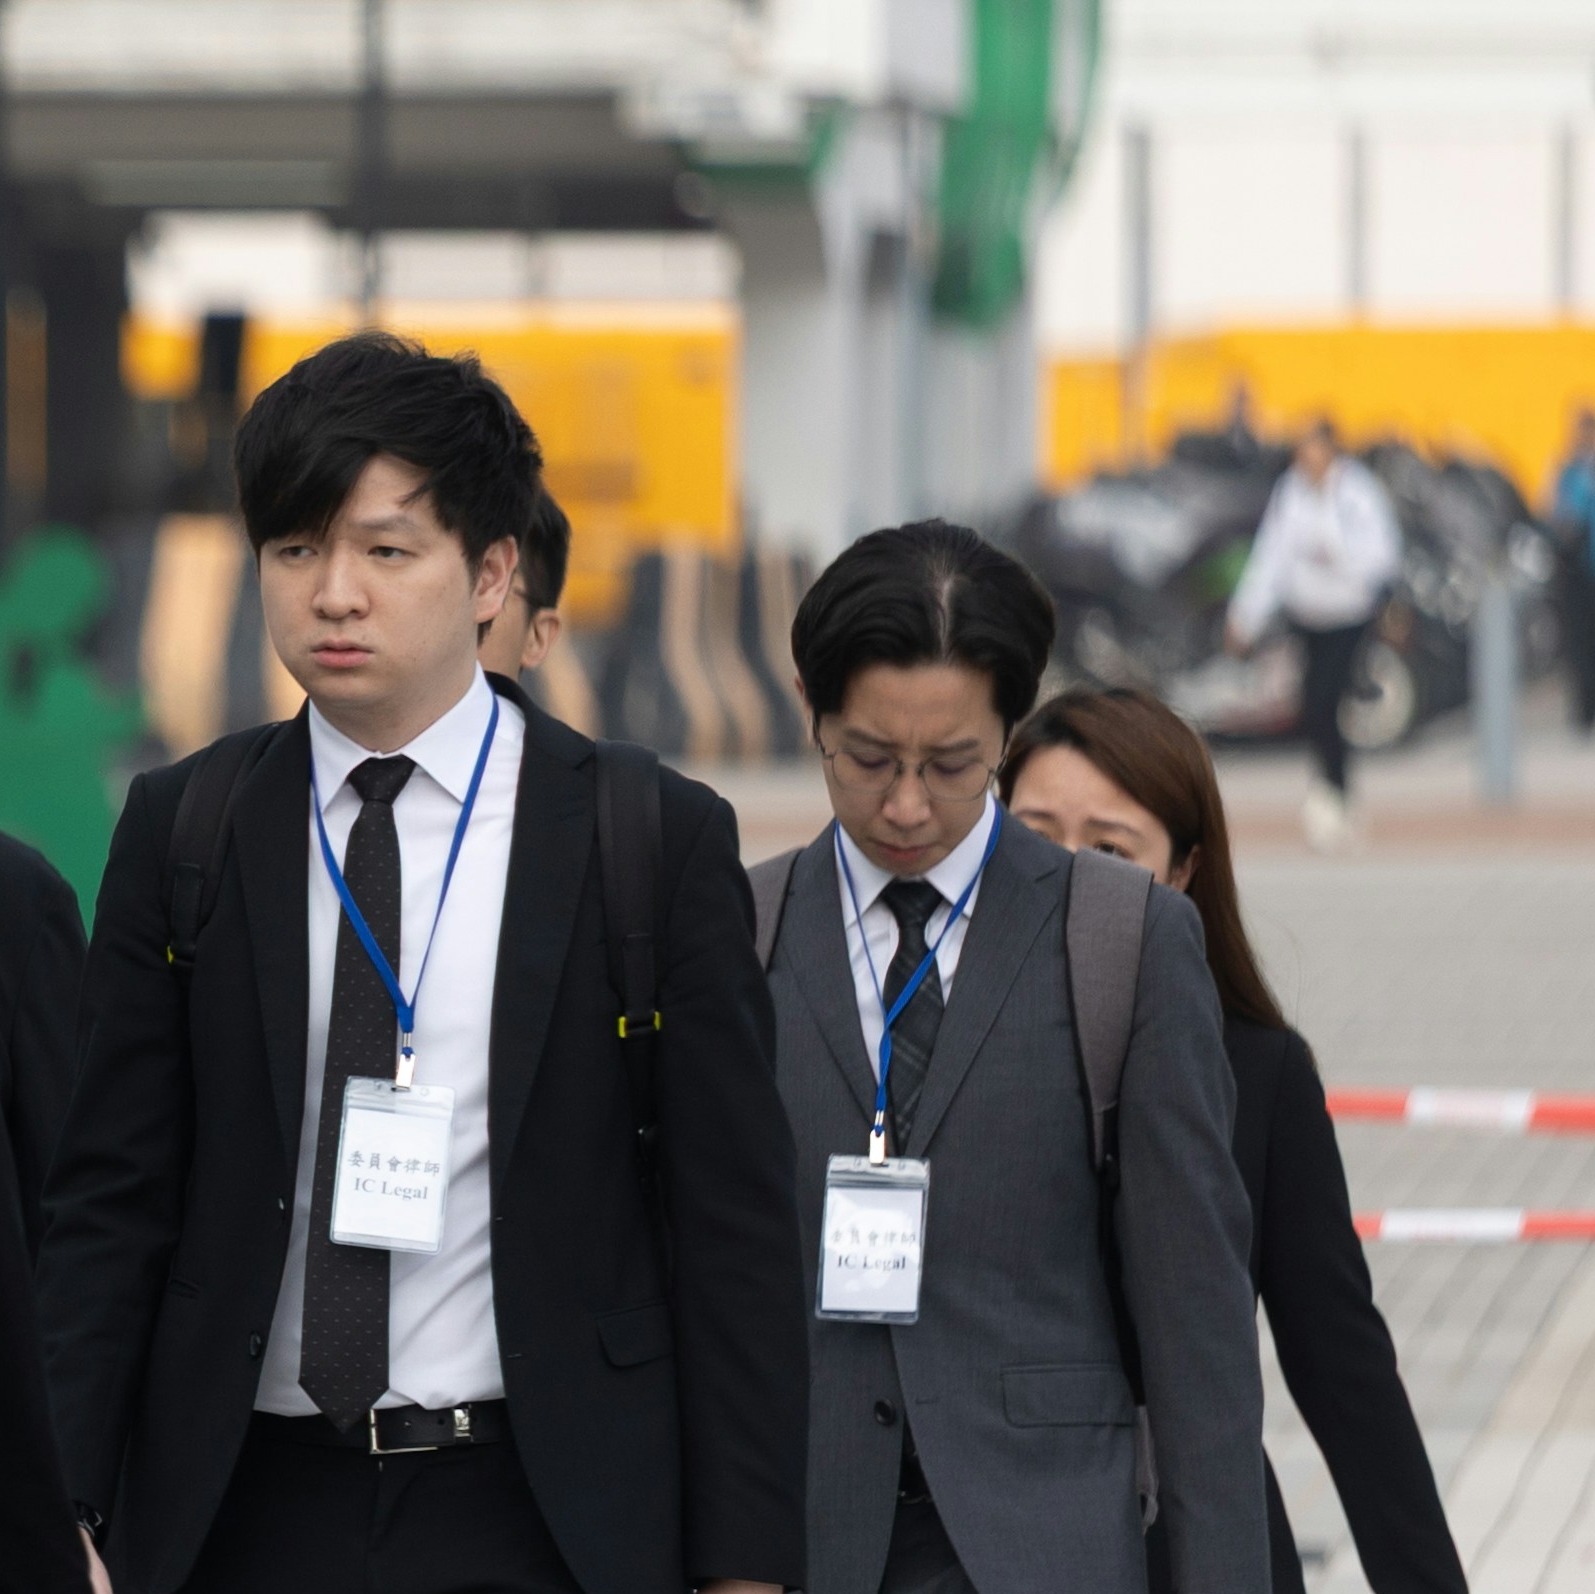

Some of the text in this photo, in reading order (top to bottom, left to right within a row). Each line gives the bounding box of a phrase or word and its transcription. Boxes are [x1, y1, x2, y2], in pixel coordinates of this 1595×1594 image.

[348, 1150, 440, 1177] 委員會律師
[354, 1177, 428, 1201] IC Legal
[837, 1254, 906, 1271] IC Legal
